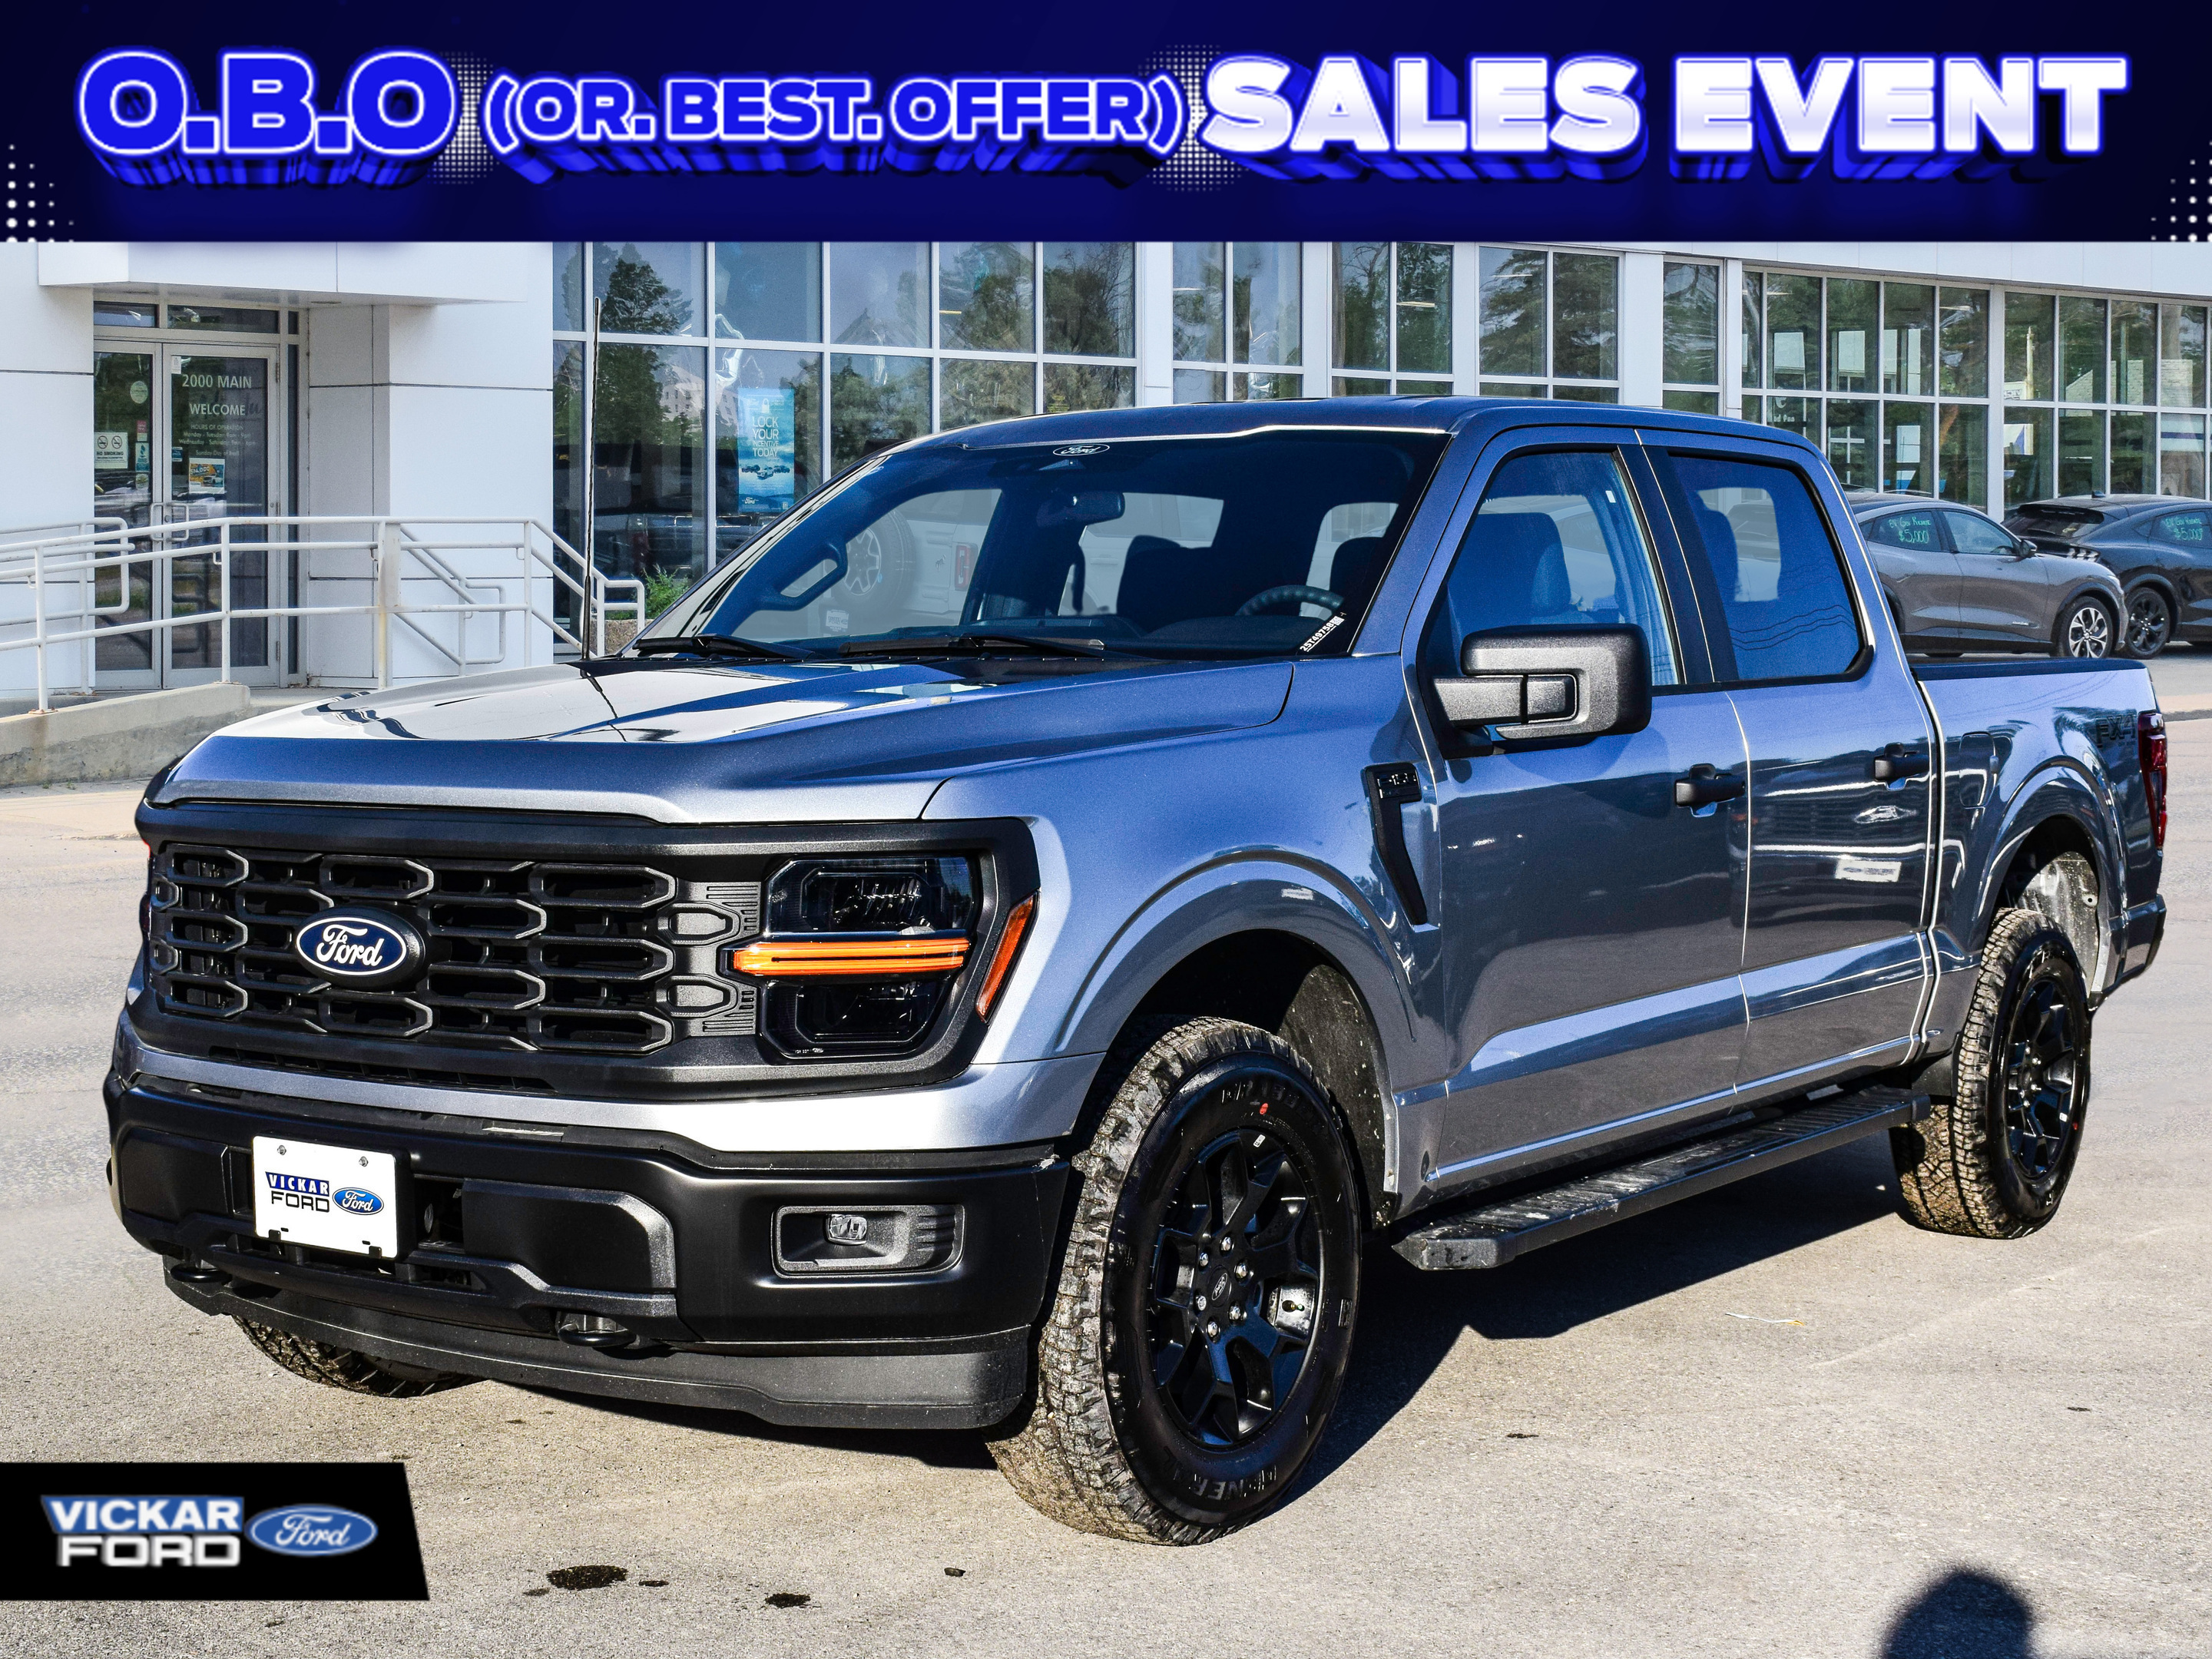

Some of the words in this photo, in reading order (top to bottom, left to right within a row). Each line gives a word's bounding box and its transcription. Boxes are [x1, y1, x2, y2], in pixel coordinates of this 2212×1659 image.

[182, 373, 214, 388] 2000
[217, 375, 253, 389] MAIN
[189, 403, 247, 416] WELCOME
[752, 416, 779, 428] LOCK
[752, 428, 780, 440] YOUR
[752, 448, 779, 458] TODAY
[1060, 445, 1101, 455] Ford
[2095, 714, 2136, 748] FX4
[316, 923, 385, 968] Ford
[268, 1173, 329, 1197] VICKAR
[270, 1190, 330, 1214] FORD
[341, 1190, 374, 1212] Ford
